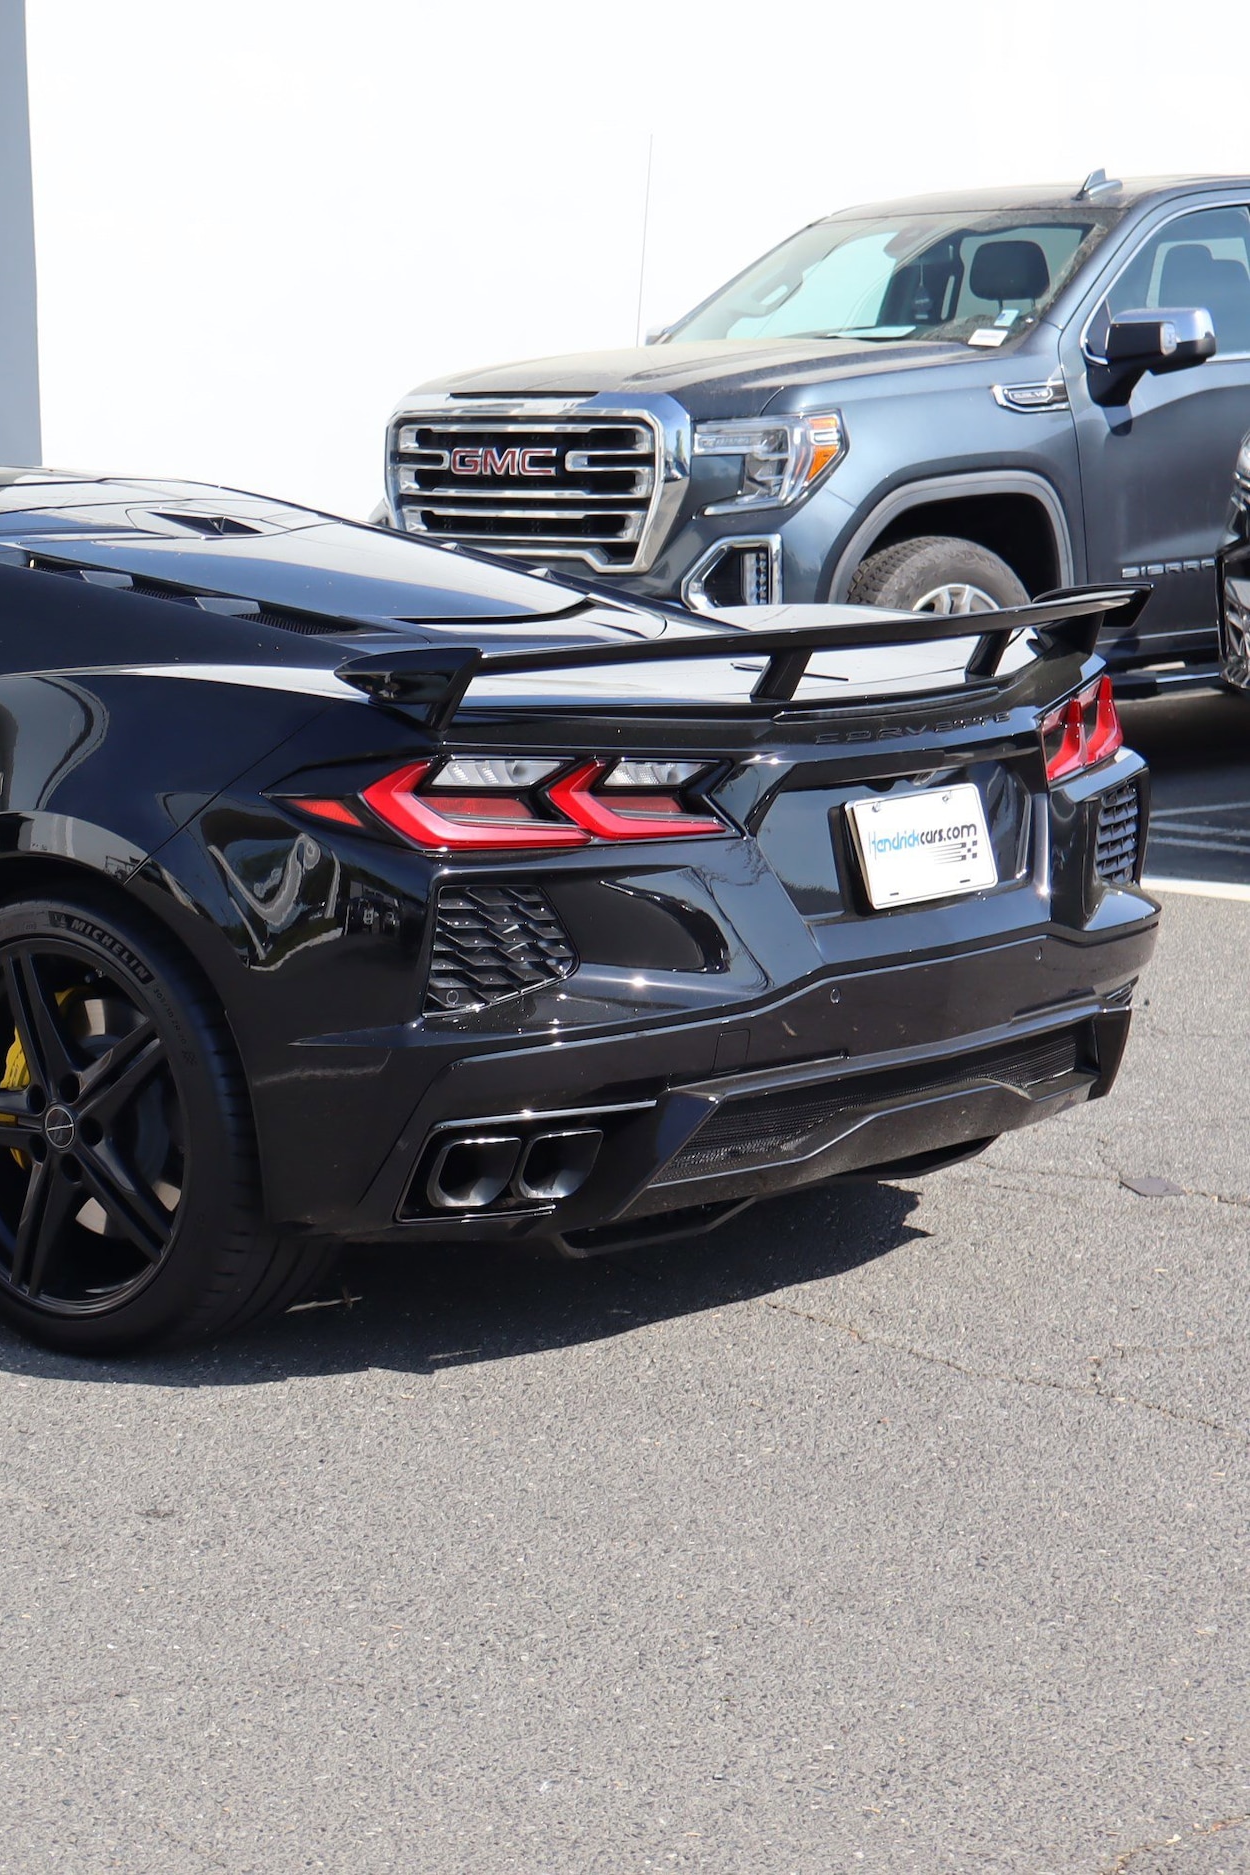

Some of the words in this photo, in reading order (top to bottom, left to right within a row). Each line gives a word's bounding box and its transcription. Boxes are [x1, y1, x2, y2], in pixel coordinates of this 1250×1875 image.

[451, 447, 557, 476] GMC
[1122, 558, 1215, 578] SIERRA
[70, 918, 149, 980] MICHELIN
